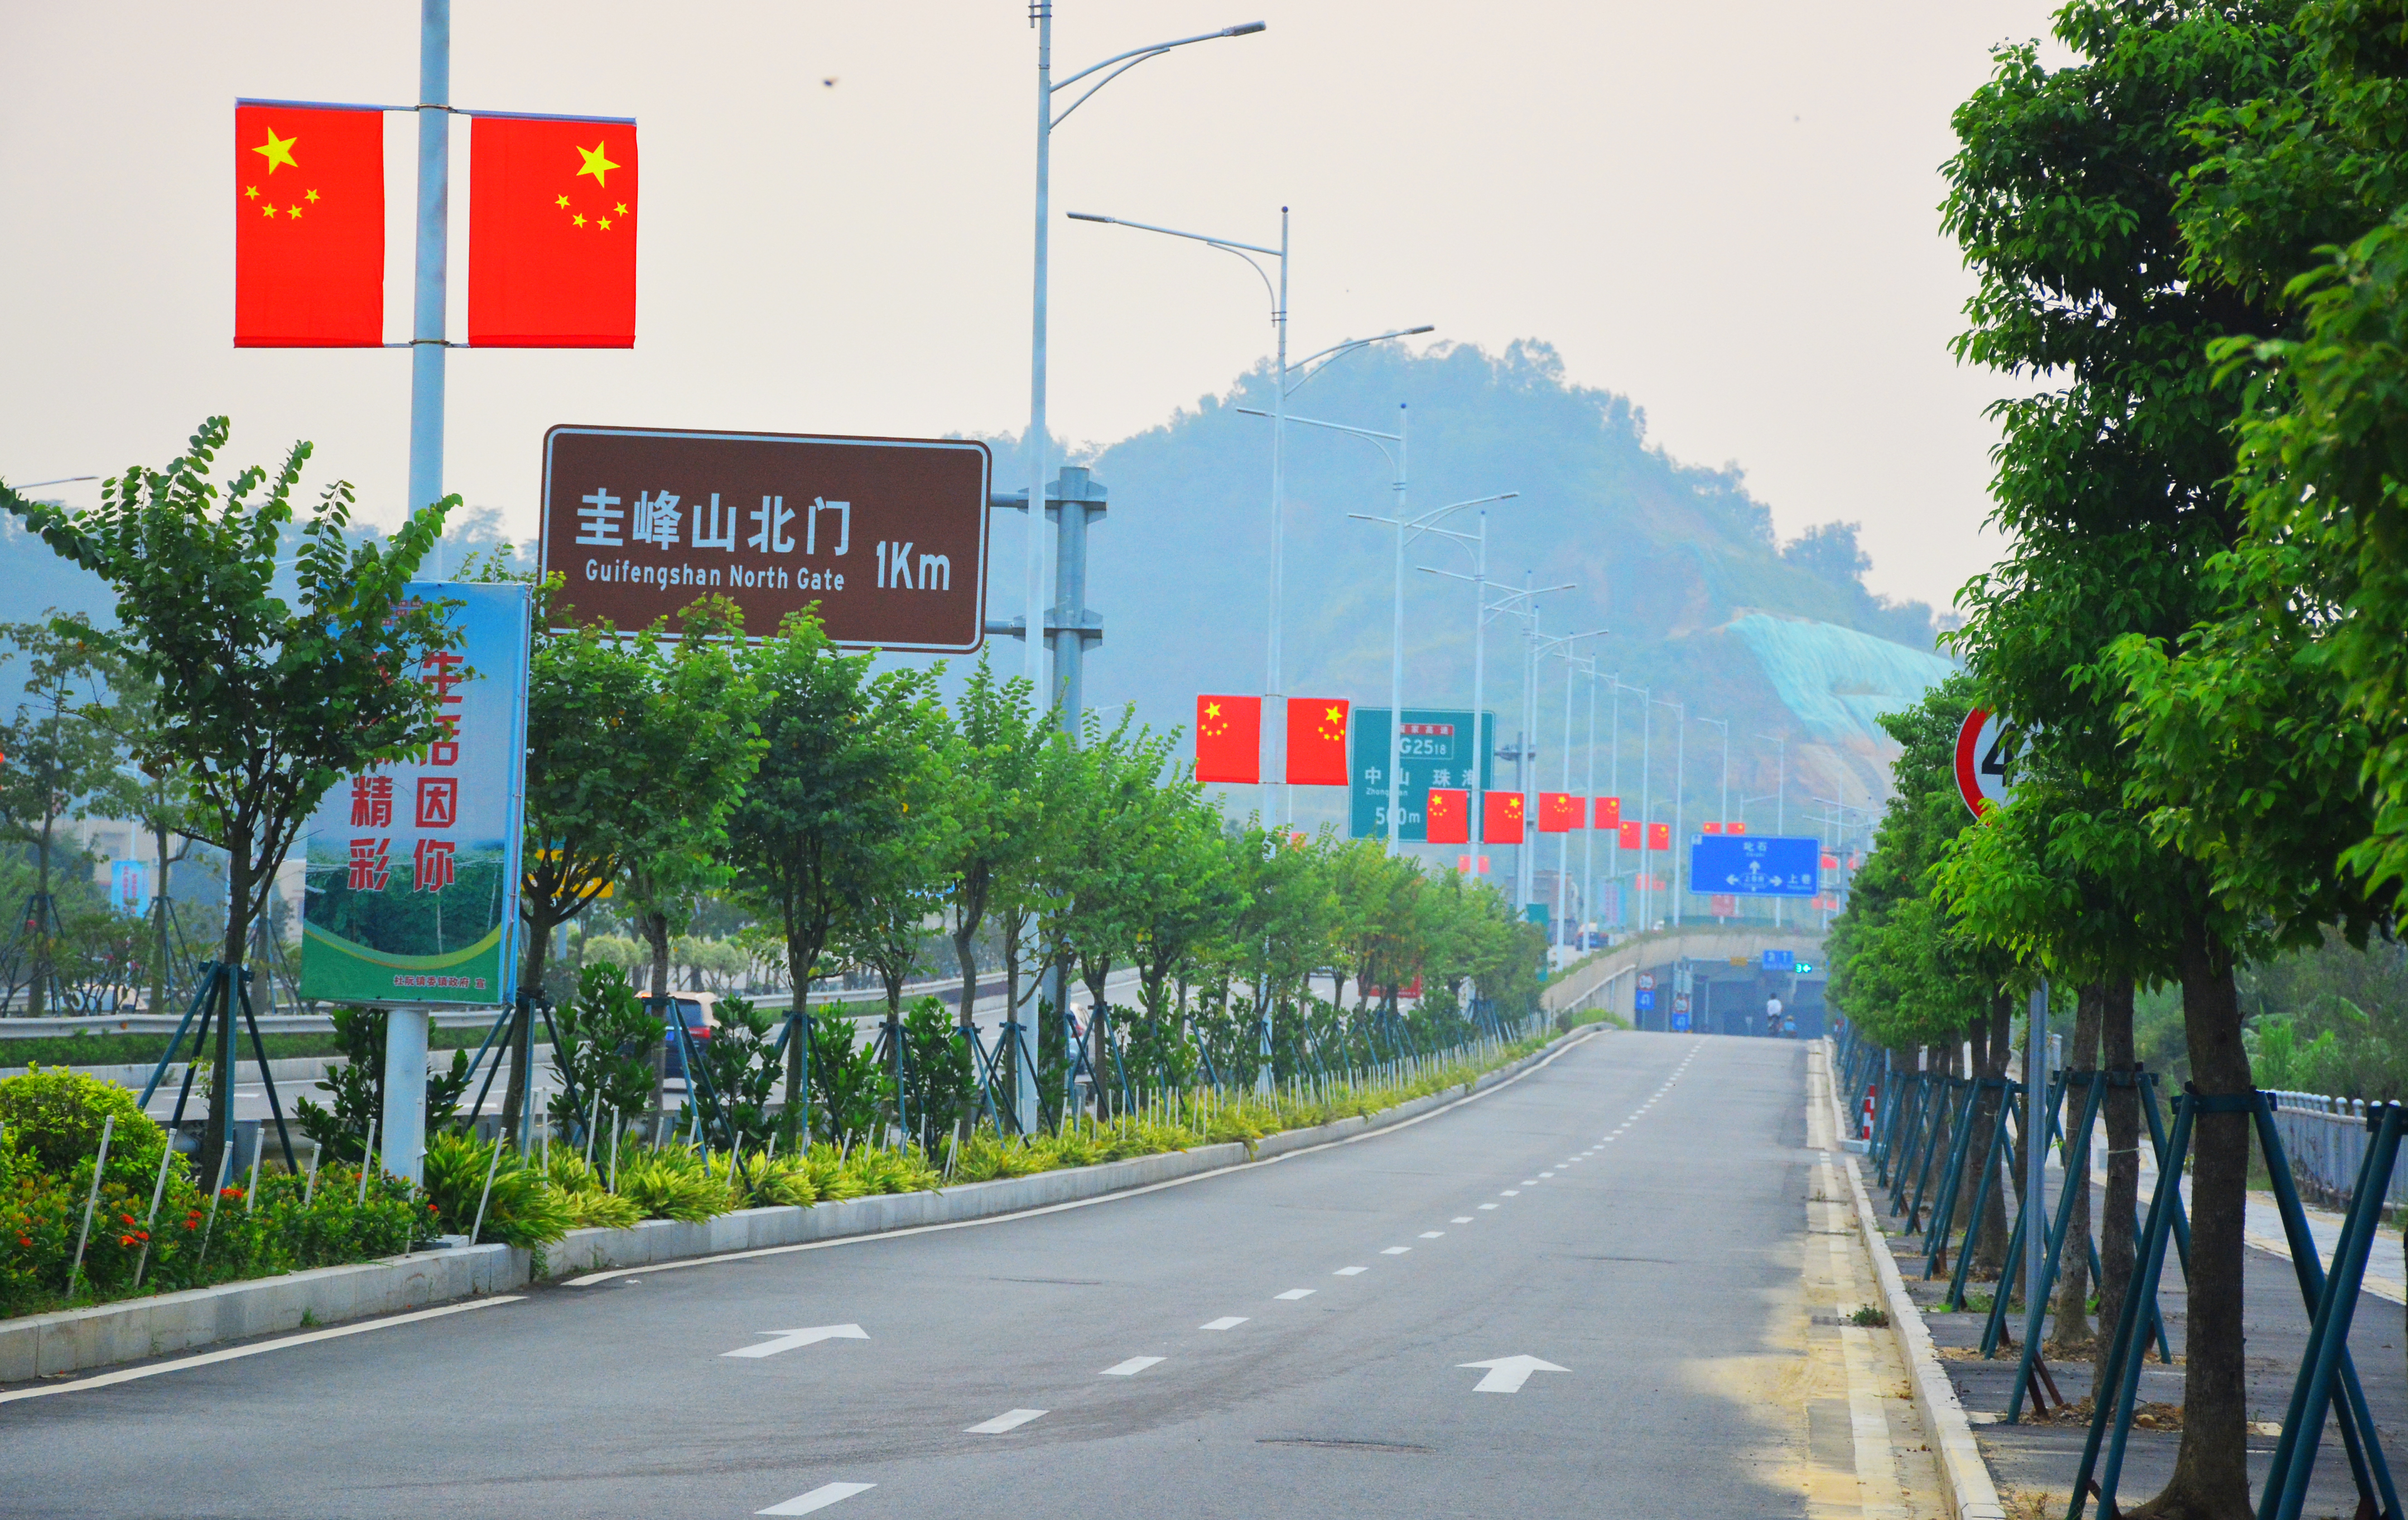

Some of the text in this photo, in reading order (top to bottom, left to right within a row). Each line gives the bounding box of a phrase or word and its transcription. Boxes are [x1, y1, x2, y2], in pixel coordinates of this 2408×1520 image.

[575, 487, 850, 556] 圭峰山北门
[586, 559, 845, 591] Guifengshan North Gate
[876, 541, 950, 591] 1Km
[1366, 787, 1408, 797] Zhongan
[393, 975, 486, 989] 杜阮镇委镇政府 宣
